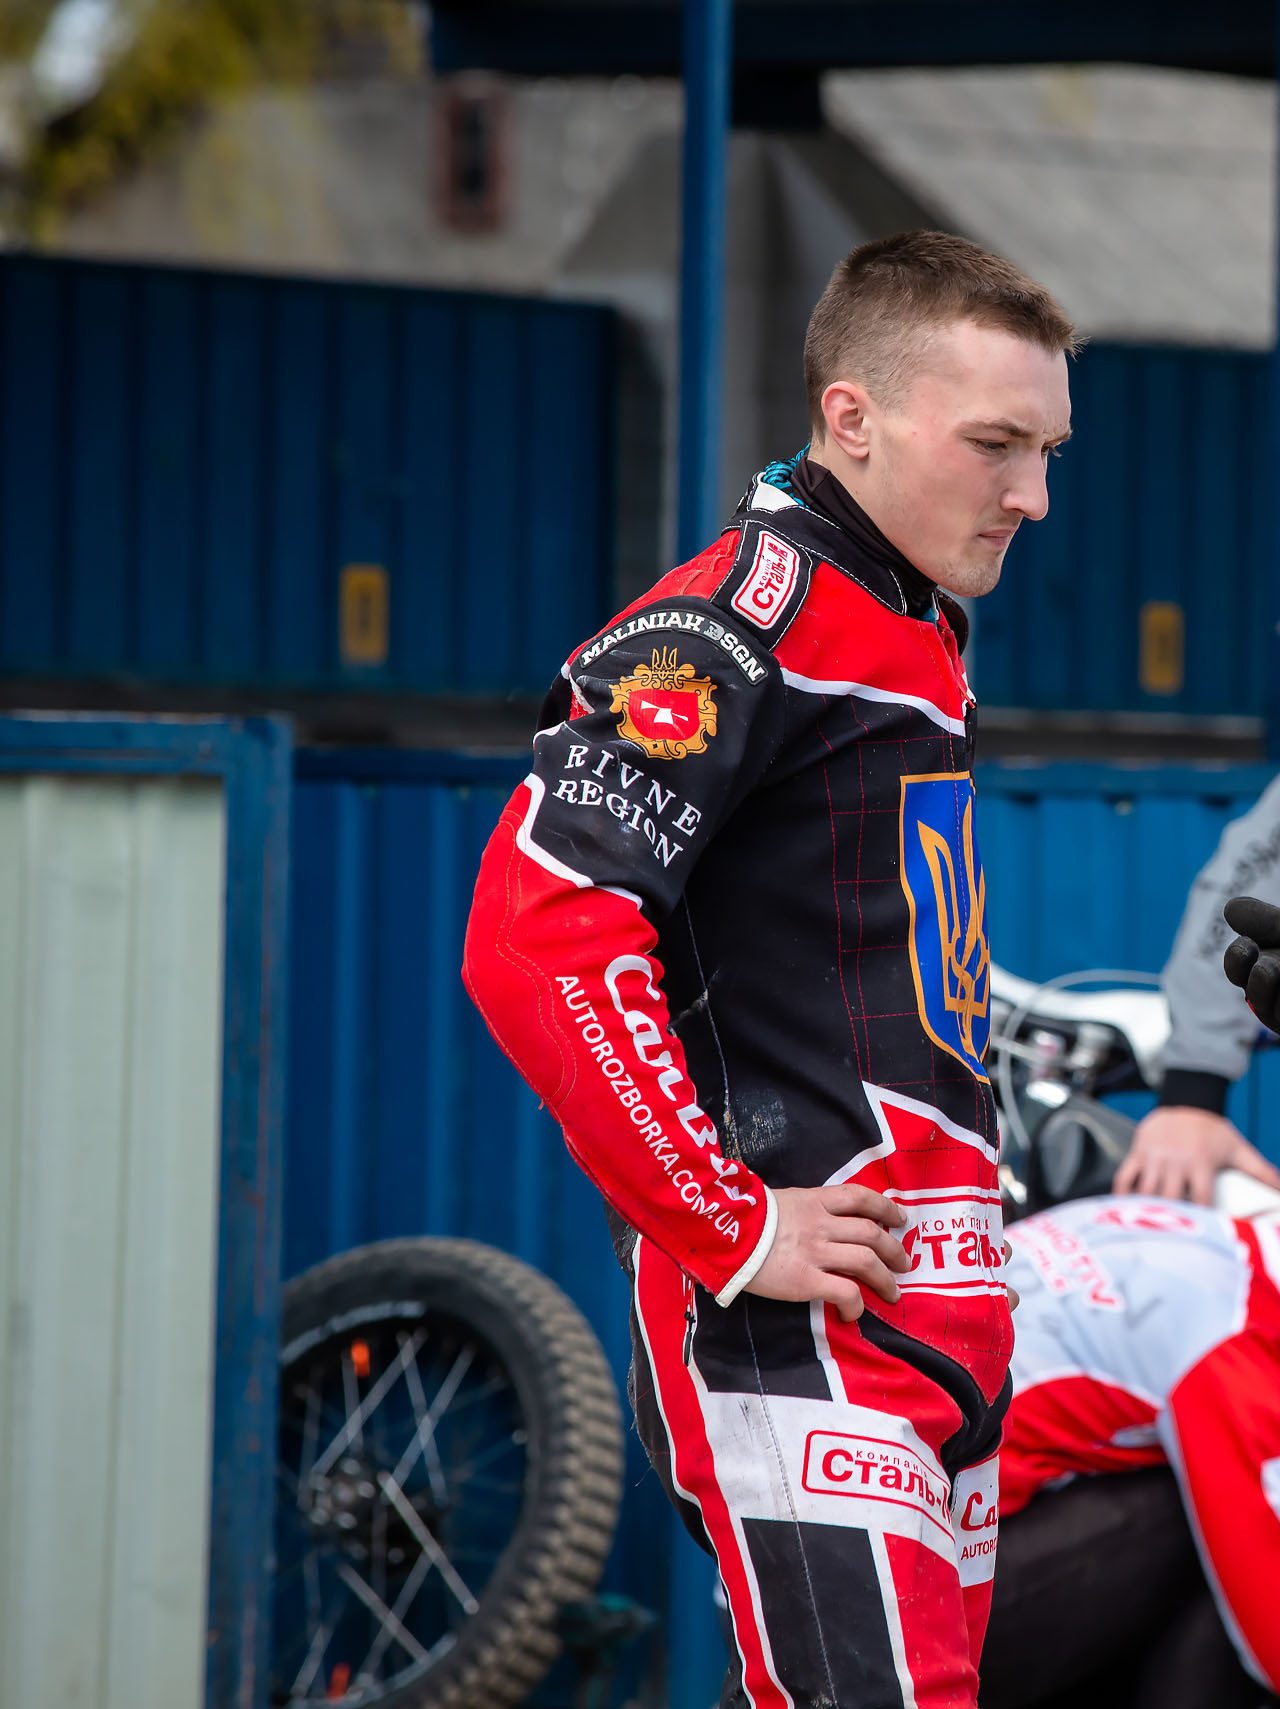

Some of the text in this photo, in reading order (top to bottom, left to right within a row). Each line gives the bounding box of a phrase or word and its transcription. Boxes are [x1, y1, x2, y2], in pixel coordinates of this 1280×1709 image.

[551, 779, 684, 868] REGION
[563, 744, 702, 837] RIVNE
[555, 975, 741, 1244] AUTOROZBORKA.COM.UA
